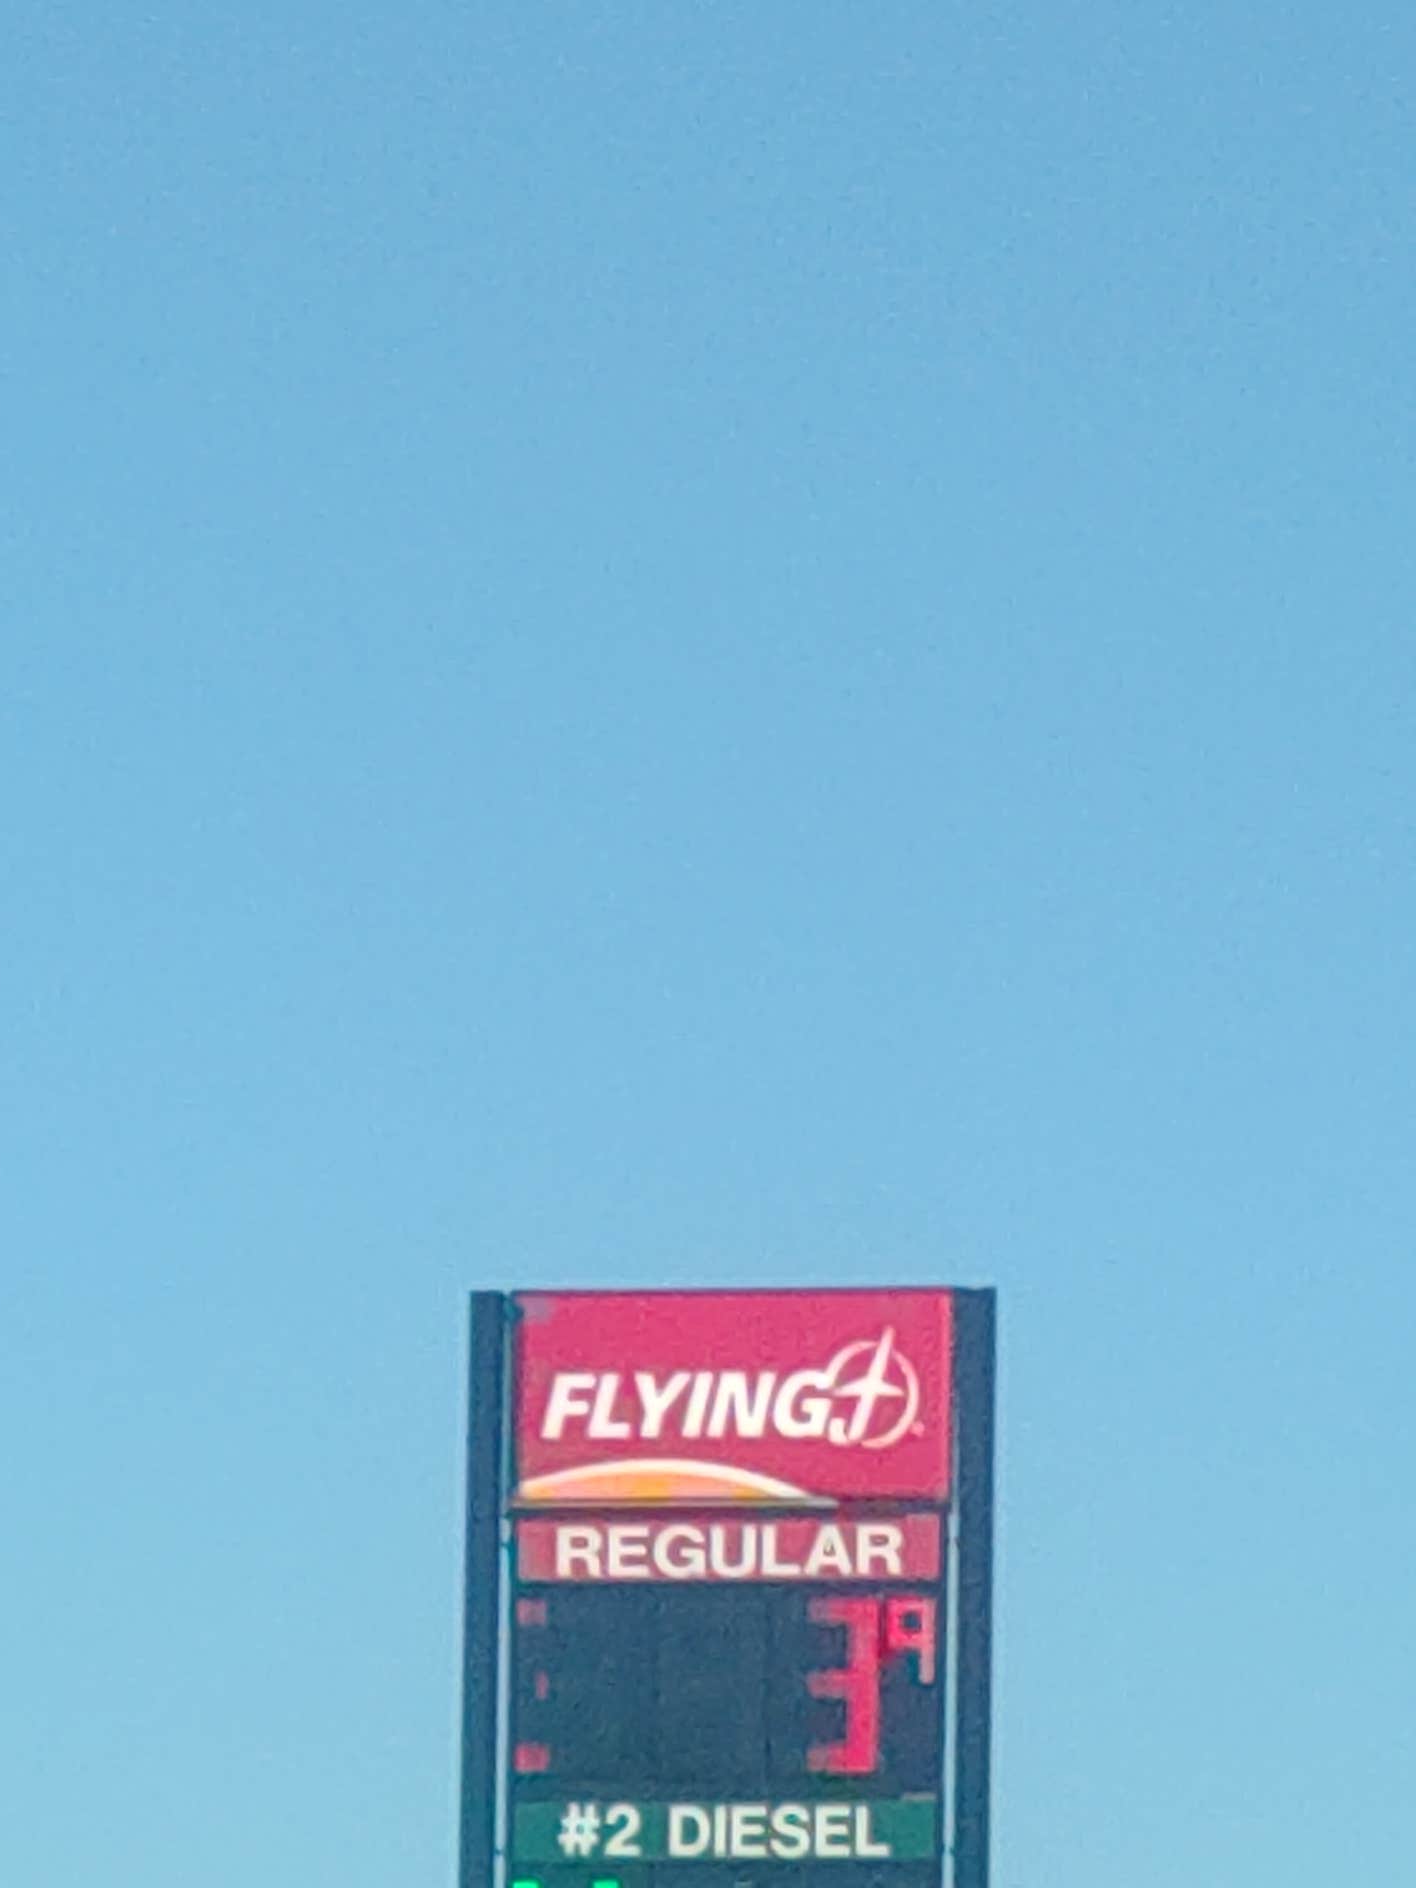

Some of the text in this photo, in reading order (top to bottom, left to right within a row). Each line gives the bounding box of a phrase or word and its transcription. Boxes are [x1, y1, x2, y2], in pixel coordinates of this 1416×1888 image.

[540, 1370, 832, 1440] FLYING
[555, 1523, 904, 1579] REGULAR
[557, 1802, 890, 1858] #2 DIESEL
